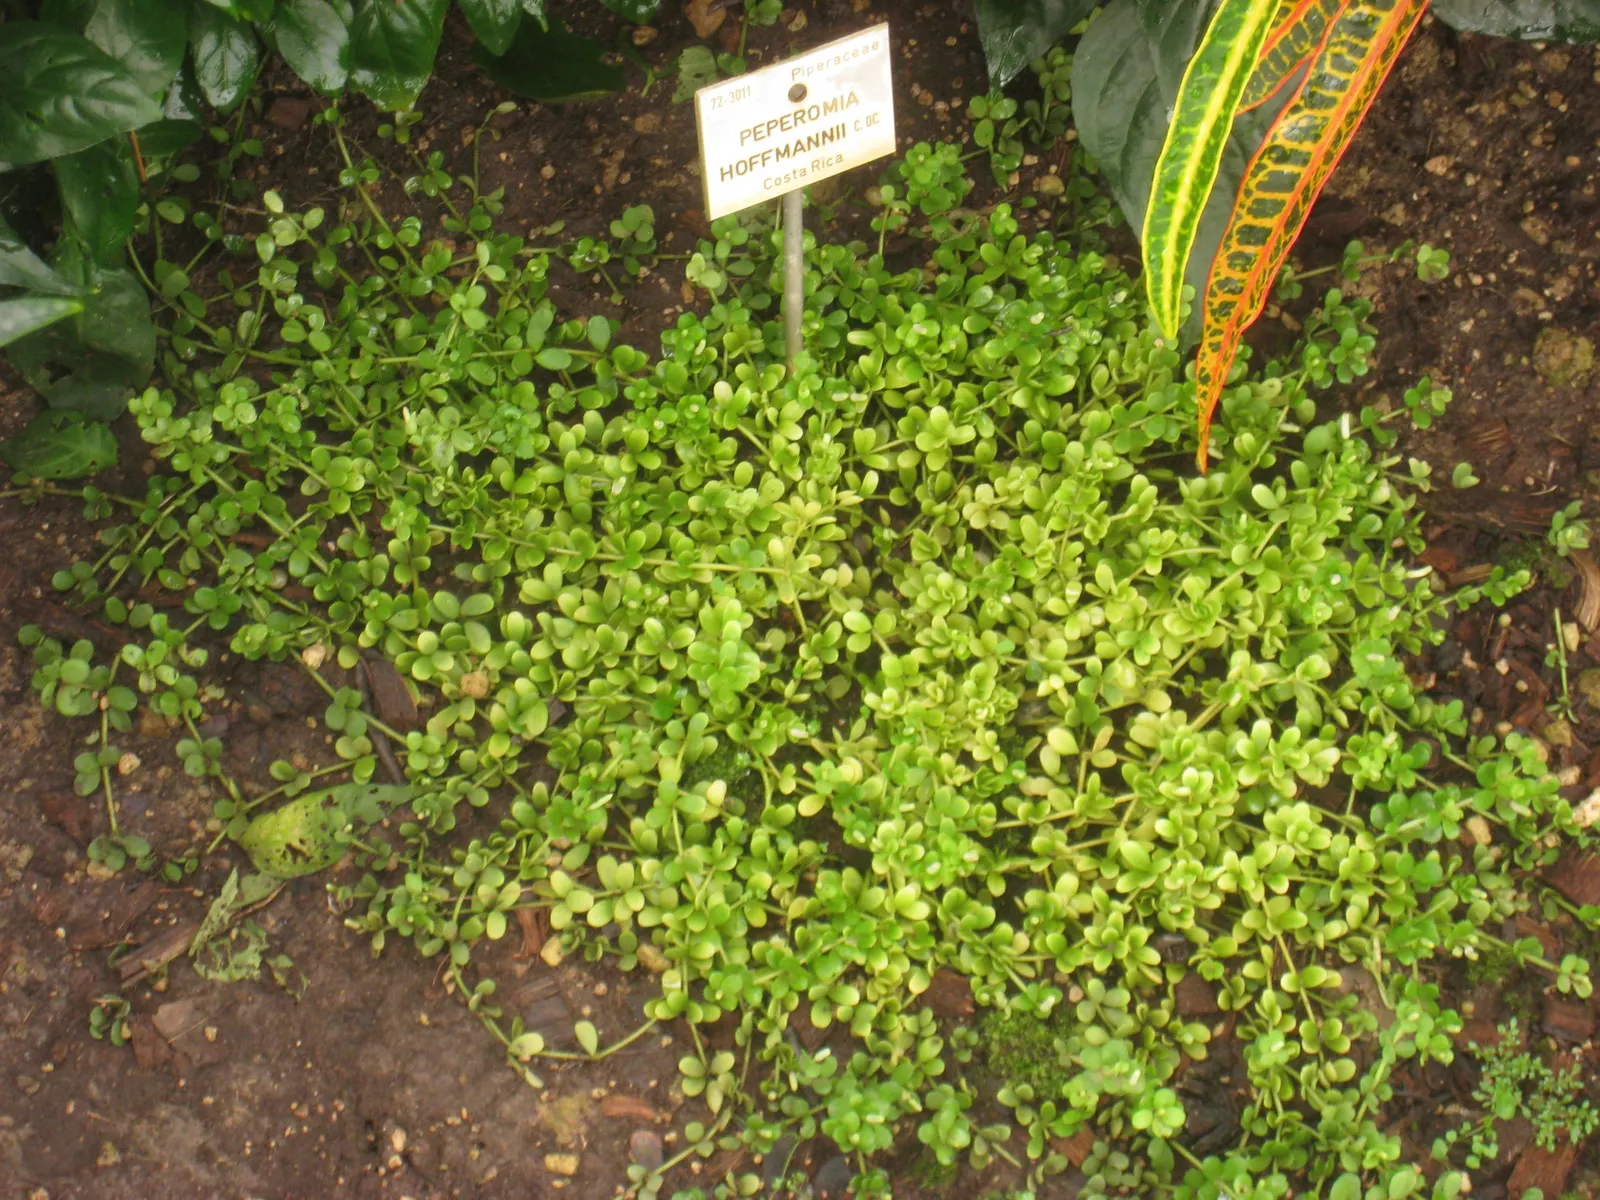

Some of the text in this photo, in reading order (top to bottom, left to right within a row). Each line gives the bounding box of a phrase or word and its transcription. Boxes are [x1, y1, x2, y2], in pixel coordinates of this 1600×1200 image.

[791, 40, 880, 81] Piperaceae
[710, 86, 751, 110] 72-3011
[740, 90, 860, 146] PEPEROMIA
[719, 123, 847, 182] HOFFMANNII
[763, 153, 844, 190] Costa Rica
